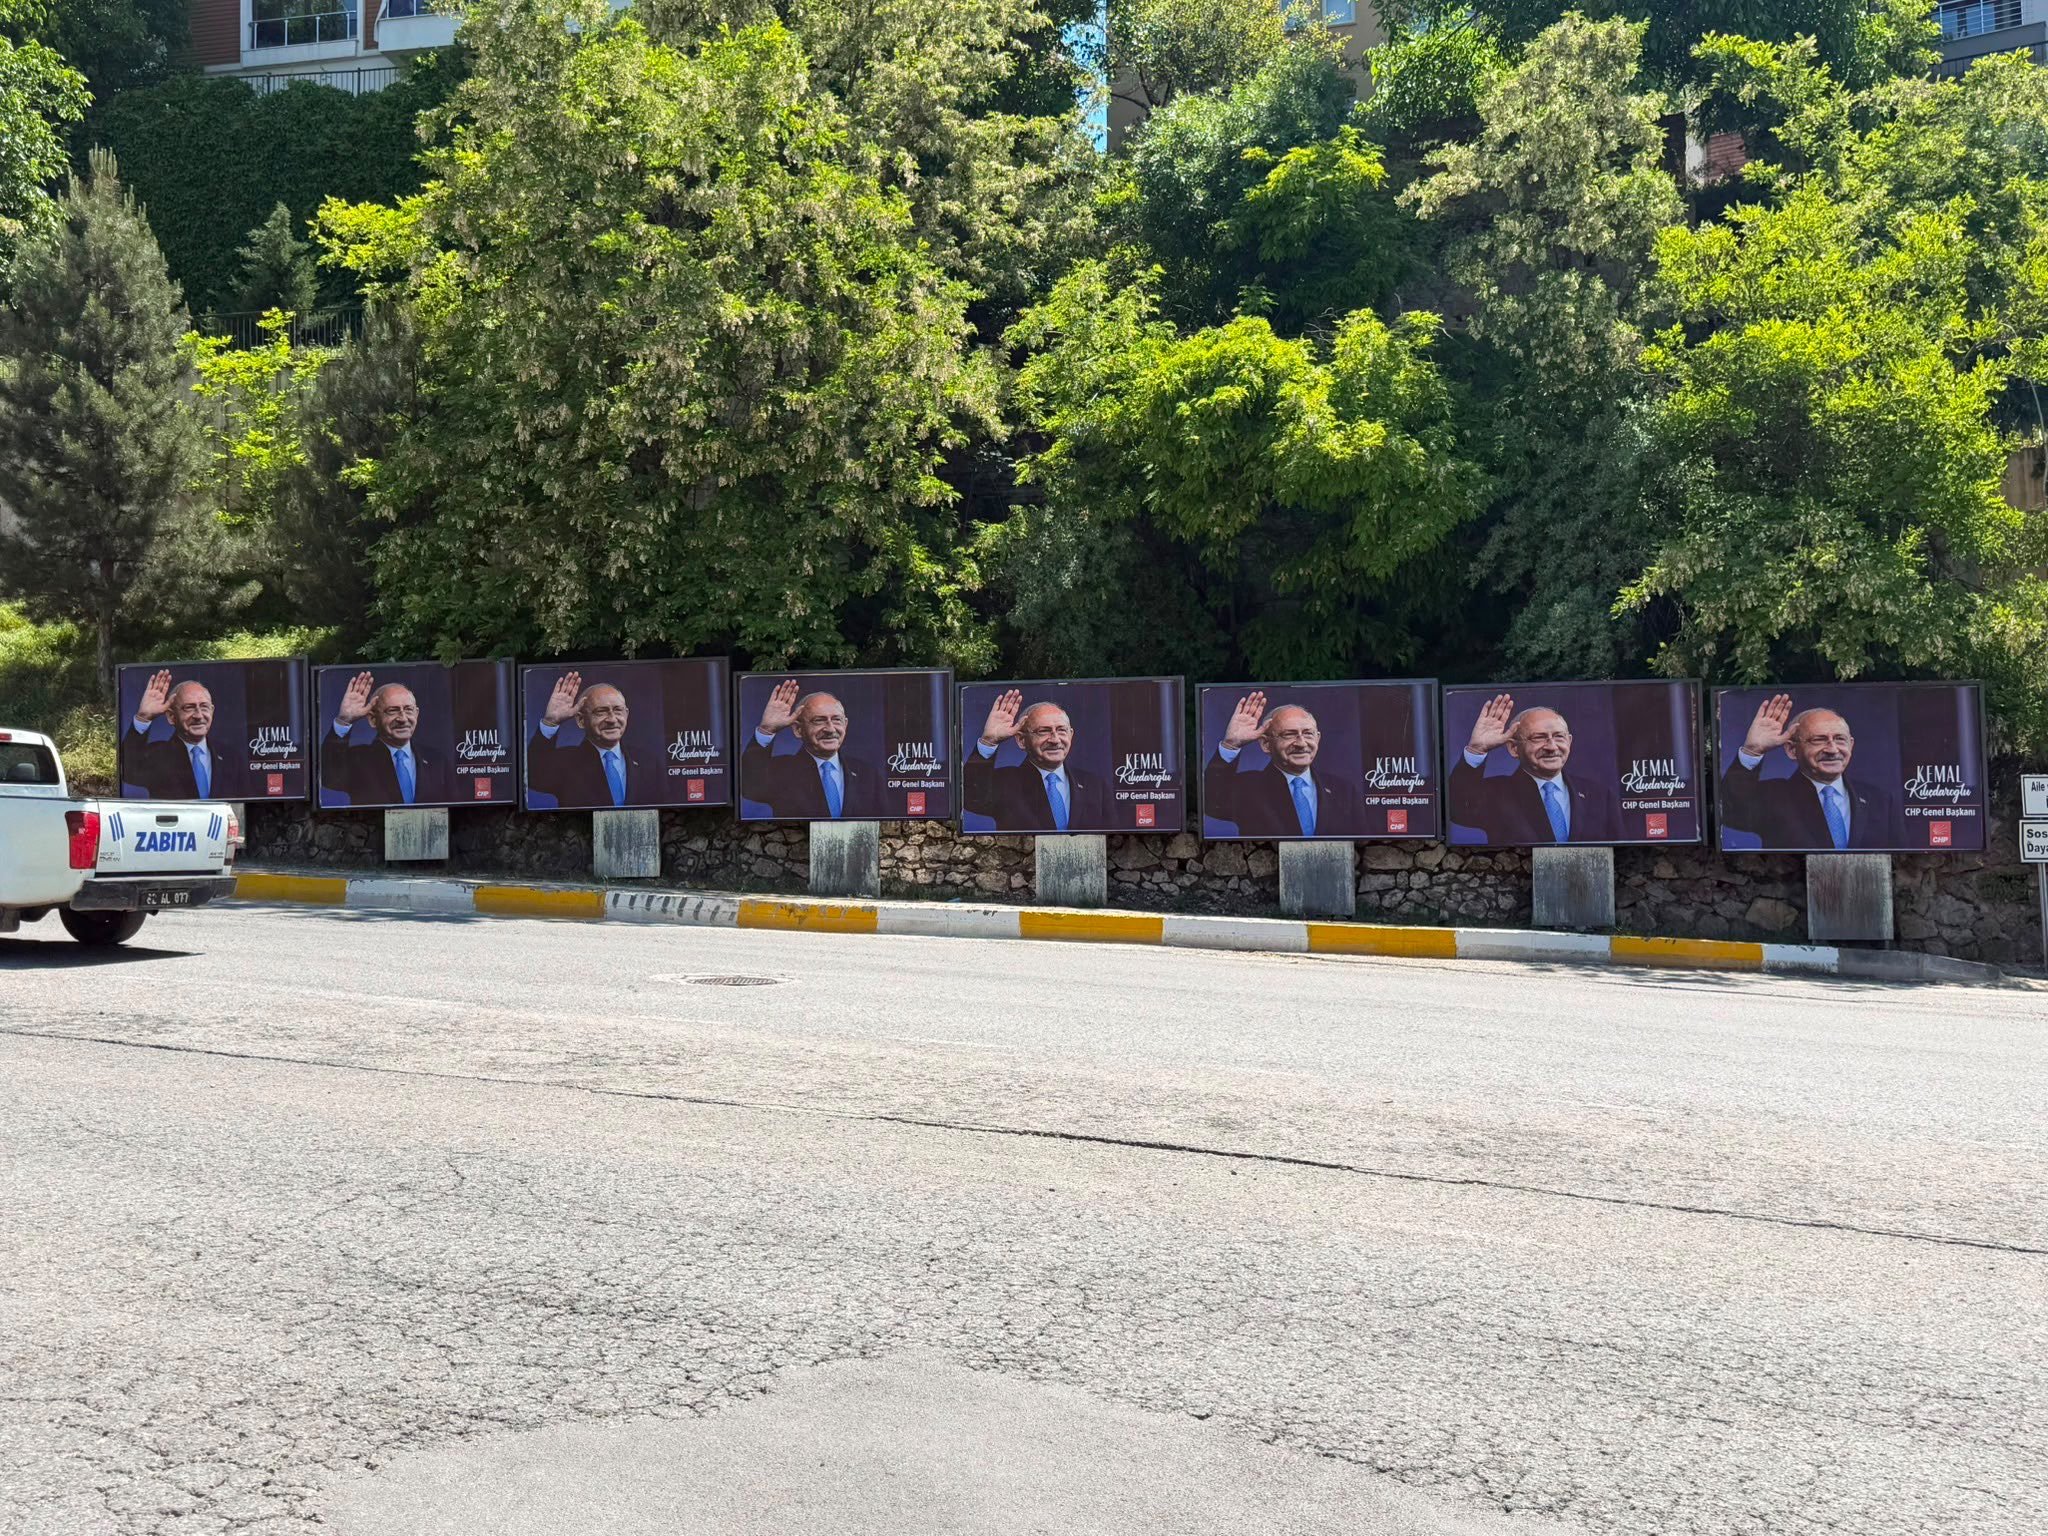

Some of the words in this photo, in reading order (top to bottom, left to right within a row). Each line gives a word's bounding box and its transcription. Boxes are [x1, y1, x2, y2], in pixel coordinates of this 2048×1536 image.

[258, 726, 291, 742] KEMAL
[465, 729, 500, 745] KEMAL
[677, 730, 713, 746] KEMAL
[898, 742, 935, 758] KEMAL
[262, 762, 278, 770] Genel
[1126, 753, 1164, 769] KEMAL
[1376, 757, 1418, 774] KEMAL
[1632, 759, 1677, 777] KEMAL
[469, 766, 486, 774] Genel
[668, 768, 680, 776] CHP
[1916, 765, 1963, 783] KEMAL
[2031, 781, 2045, 792] Aile
[1115, 792, 1129, 800] CHP
[1130, 792, 1148, 800] Genel
[1365, 797, 1380, 805] CHP
[1381, 797, 1400, 805] Genel
[1622, 801, 1637, 809] CHP
[1638, 800, 1660, 809] Genel
[1661, 800, 1690, 809] Başkanı
[1904, 808, 1921, 816] CHP
[1922, 808, 1944, 816] Genel
[1946, 807, 1976, 817] Başkanı
[134, 831, 197, 852] ZABITA
